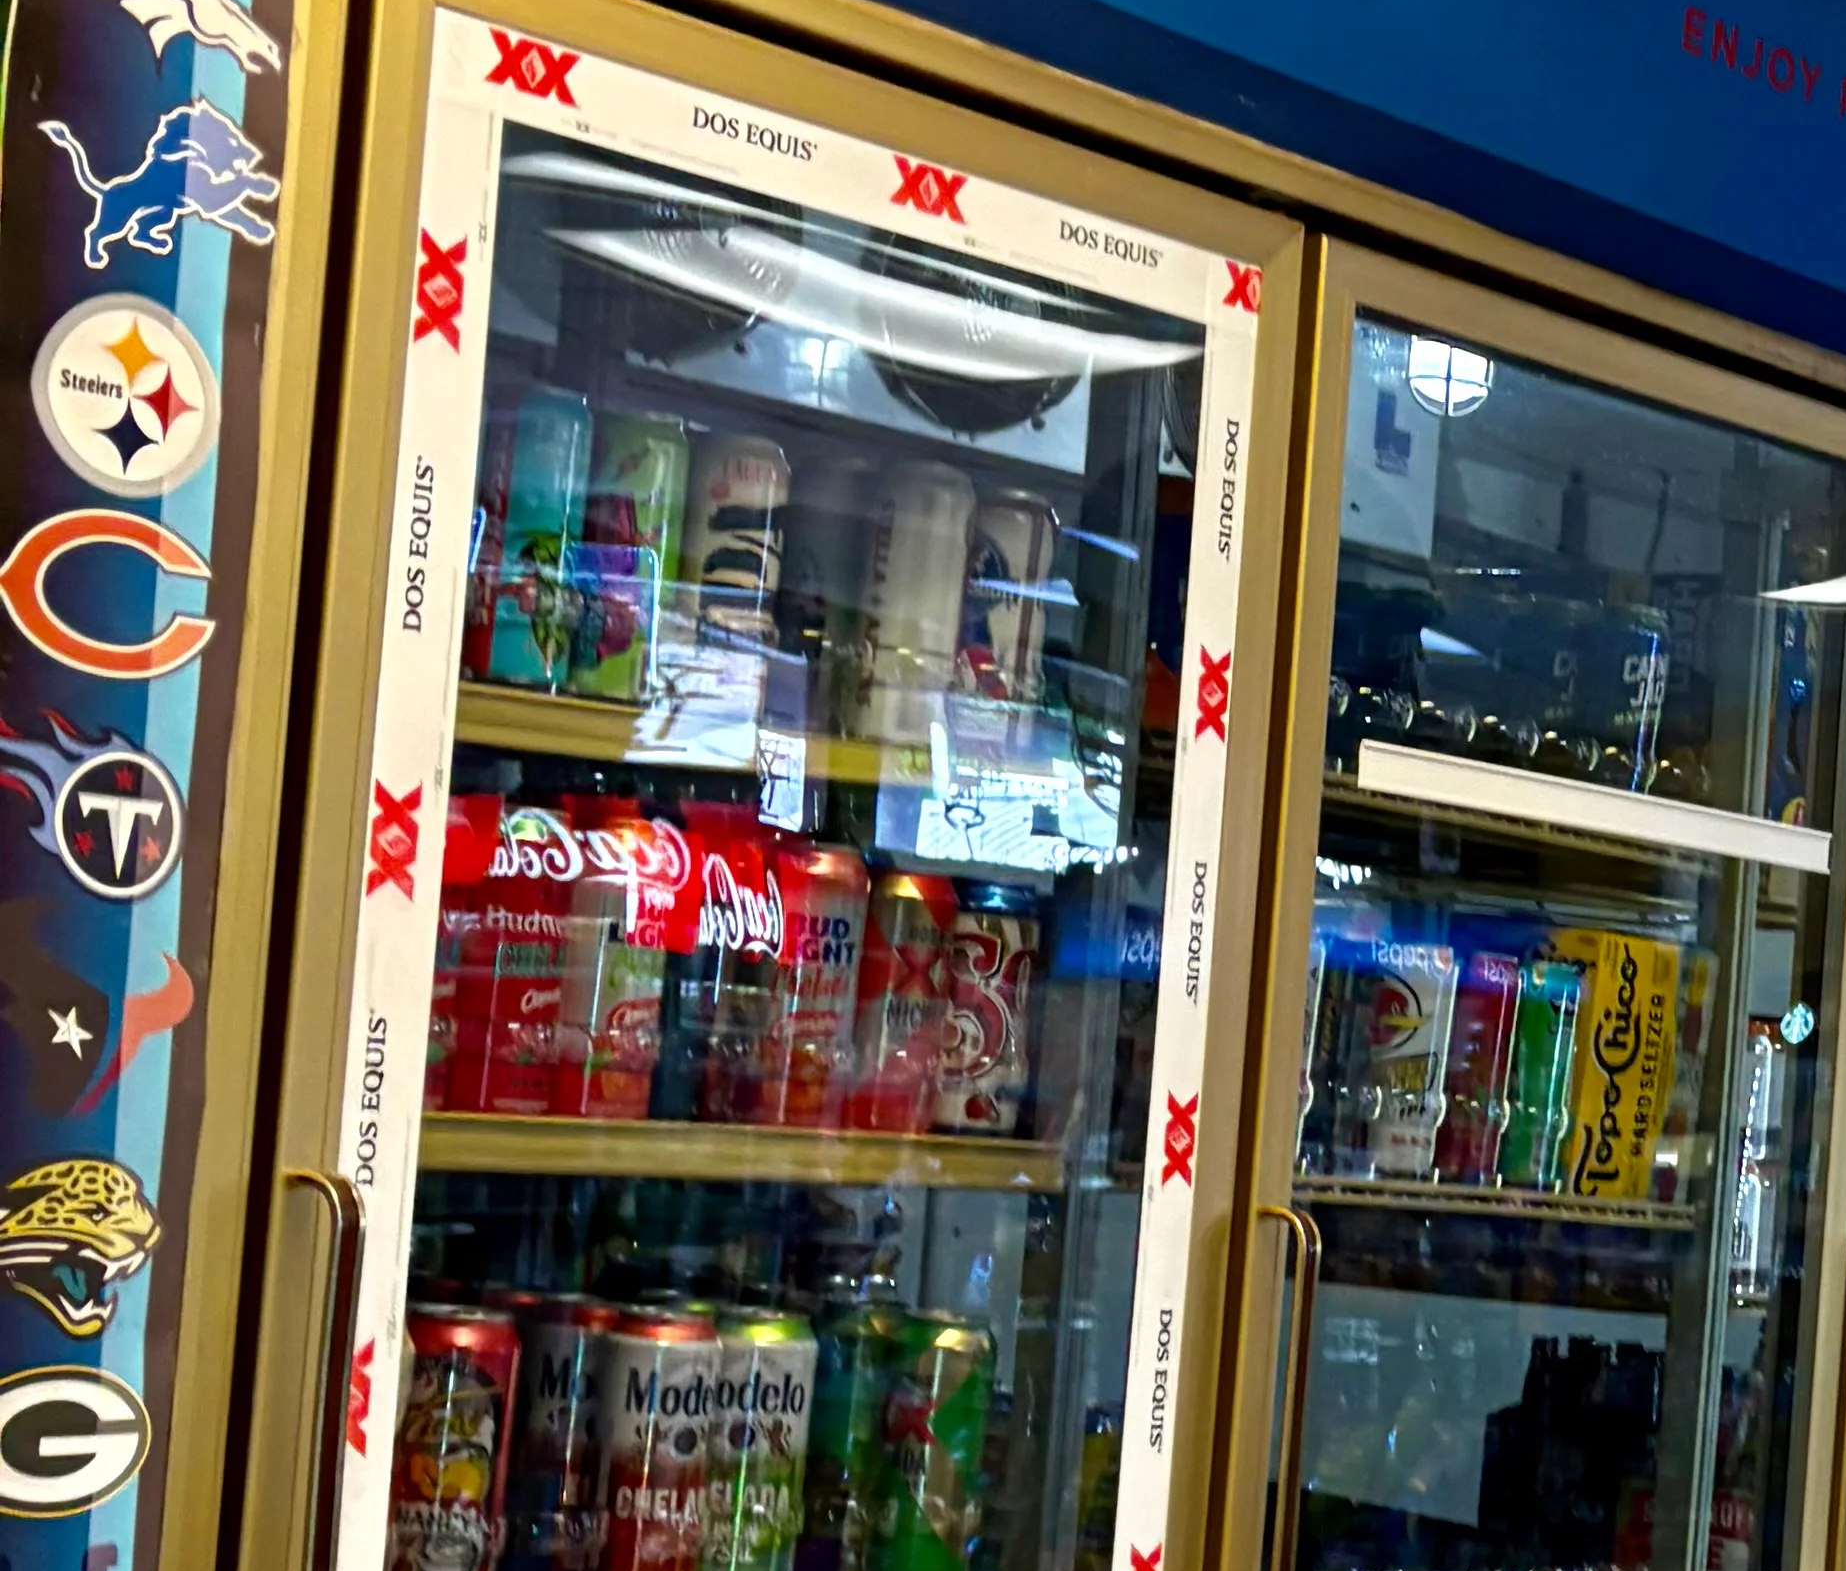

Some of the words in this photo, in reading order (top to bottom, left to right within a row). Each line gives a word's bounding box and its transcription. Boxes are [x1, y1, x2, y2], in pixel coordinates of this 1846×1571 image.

[1681, 6, 1822, 102] ENJOY
[692, 106, 739, 140] DOS
[747, 123, 816, 161] EQUIS
[1059, 221, 1099, 251] DOS
[1103, 234, 1163, 268] EQUIS
[59, 368, 124, 404] Steelers
[1224, 418, 1240, 472] DOS
[408, 463, 435, 563] EQUIS
[1217, 477, 1235, 561] EQUIS
[403, 567, 425, 635] DOS
[1191, 862, 1207, 916] DOS
[1185, 919, 1203, 1005] EQUIS
[1593, 942, 1642, 1079] Chico
[1637, 992, 1666, 1090] SELTZER
[363, 1015, 388, 1118] EQUIS
[355, 1122, 379, 1187] DOS
[1572, 1075, 1623, 1197] Topo
[1629, 1093, 1652, 1156] HARD
[1157, 1309, 1171, 1363] DOS
[1149, 1369, 1168, 1452] EQUIS
